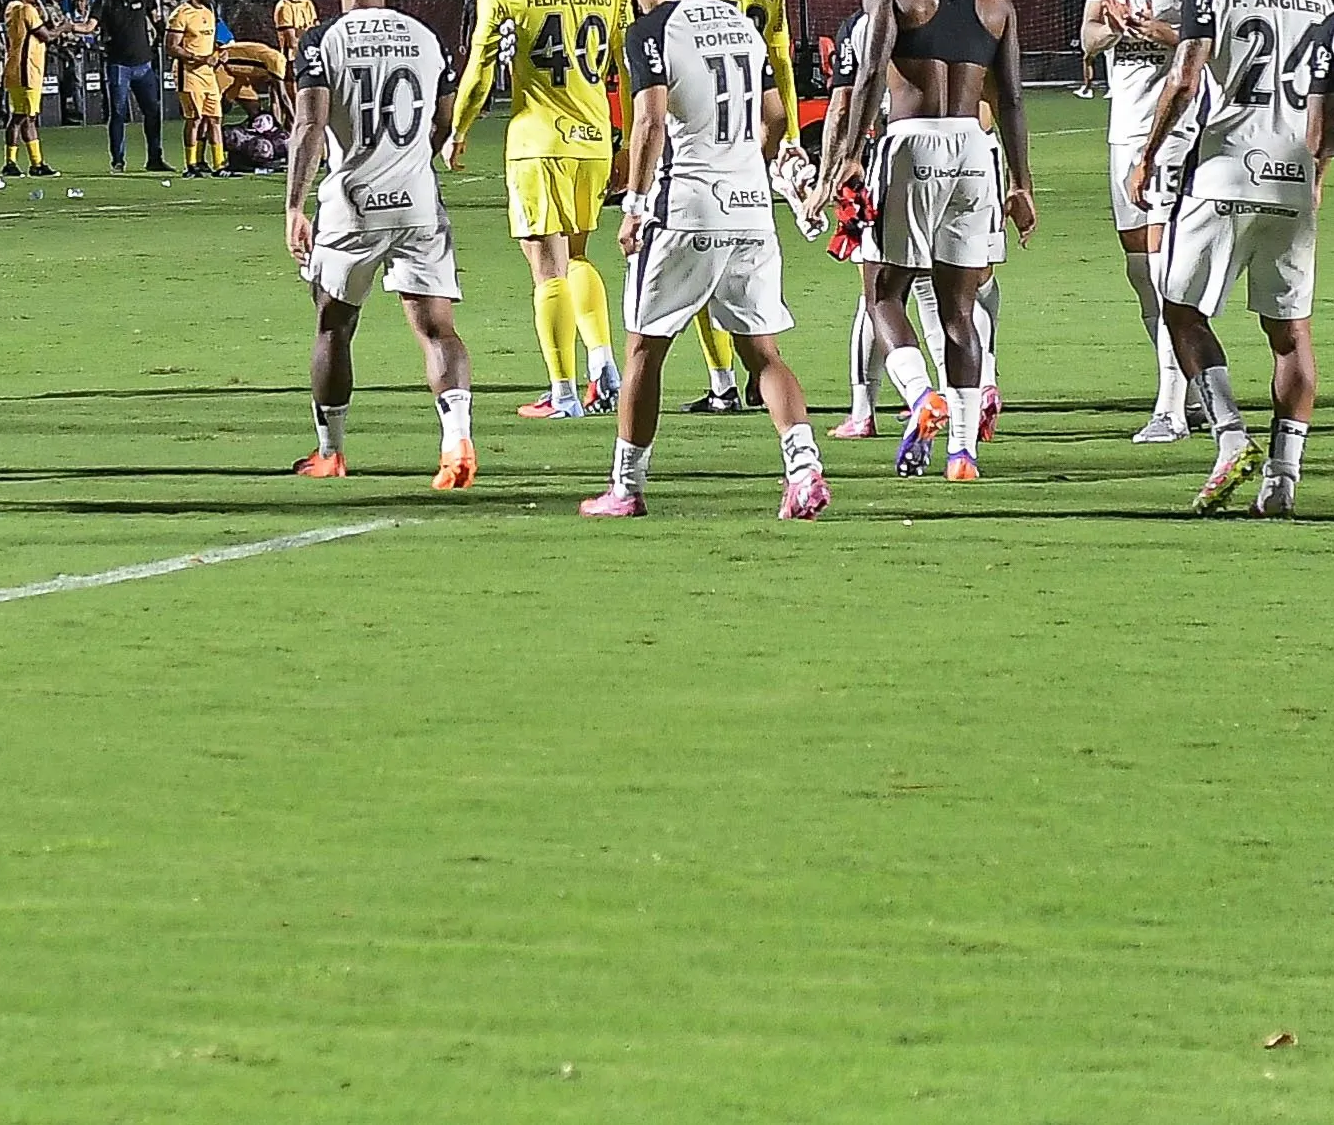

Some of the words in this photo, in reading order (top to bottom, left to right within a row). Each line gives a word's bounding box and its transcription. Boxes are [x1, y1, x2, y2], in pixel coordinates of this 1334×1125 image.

[683, 6, 730, 23] EZZE
[345, 19, 392, 35] EZZE
[694, 32, 753, 49] ROMERO
[347, 45, 420, 58] MEMPHIS
[530, 11, 609, 88] 40
[702, 52, 755, 144] 11
[346, 64, 424, 149] 10
[569, 125, 603, 139] AREA
[1262, 162, 1305, 177] AREA
[366, 191, 412, 206] AREA
[729, 190, 767, 205] AREA
